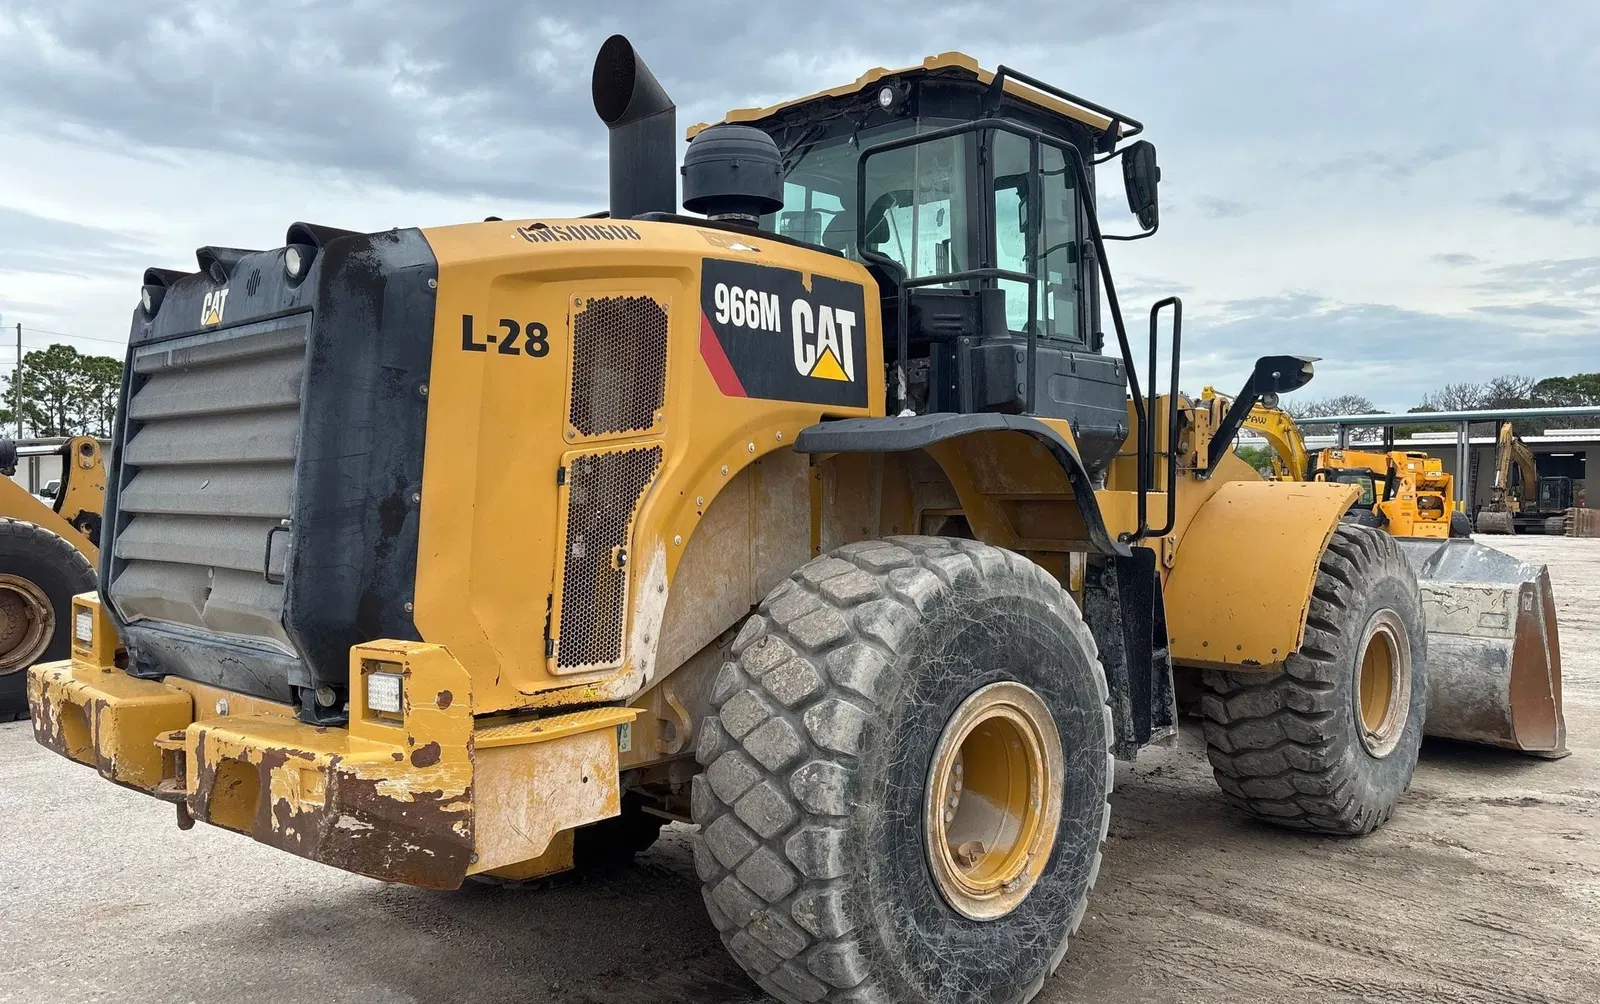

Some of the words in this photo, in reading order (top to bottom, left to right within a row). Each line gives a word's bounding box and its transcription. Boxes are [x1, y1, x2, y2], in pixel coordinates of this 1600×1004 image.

[201, 289, 229, 326] CAT
[714, 282, 781, 333] 966M
[462, 314, 550, 358] L-28
[791, 298, 856, 382] CAT
